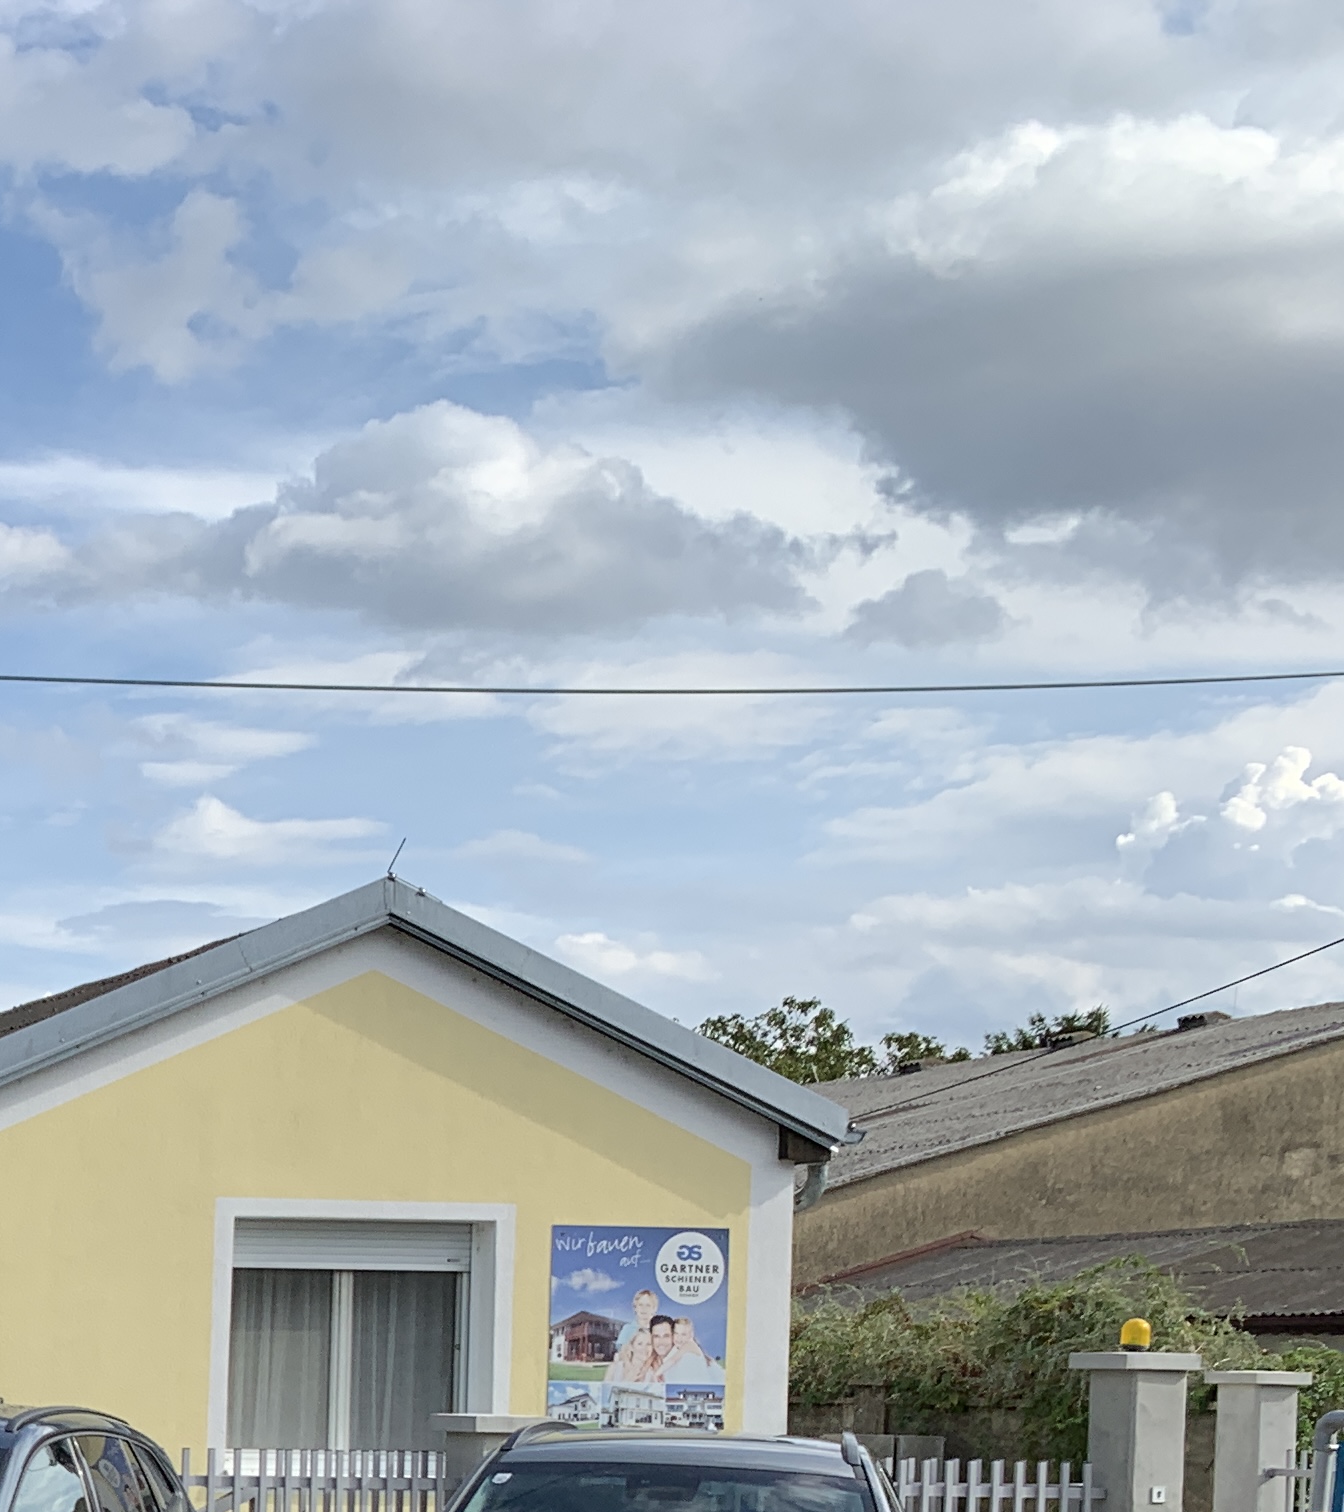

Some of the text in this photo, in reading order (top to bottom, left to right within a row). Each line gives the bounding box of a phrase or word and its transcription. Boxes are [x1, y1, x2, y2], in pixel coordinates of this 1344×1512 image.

[660, 1263, 719, 1274] GARTNER
[665, 1275, 714, 1284] SCHIENER
[679, 1285, 699, 1293] BAU
